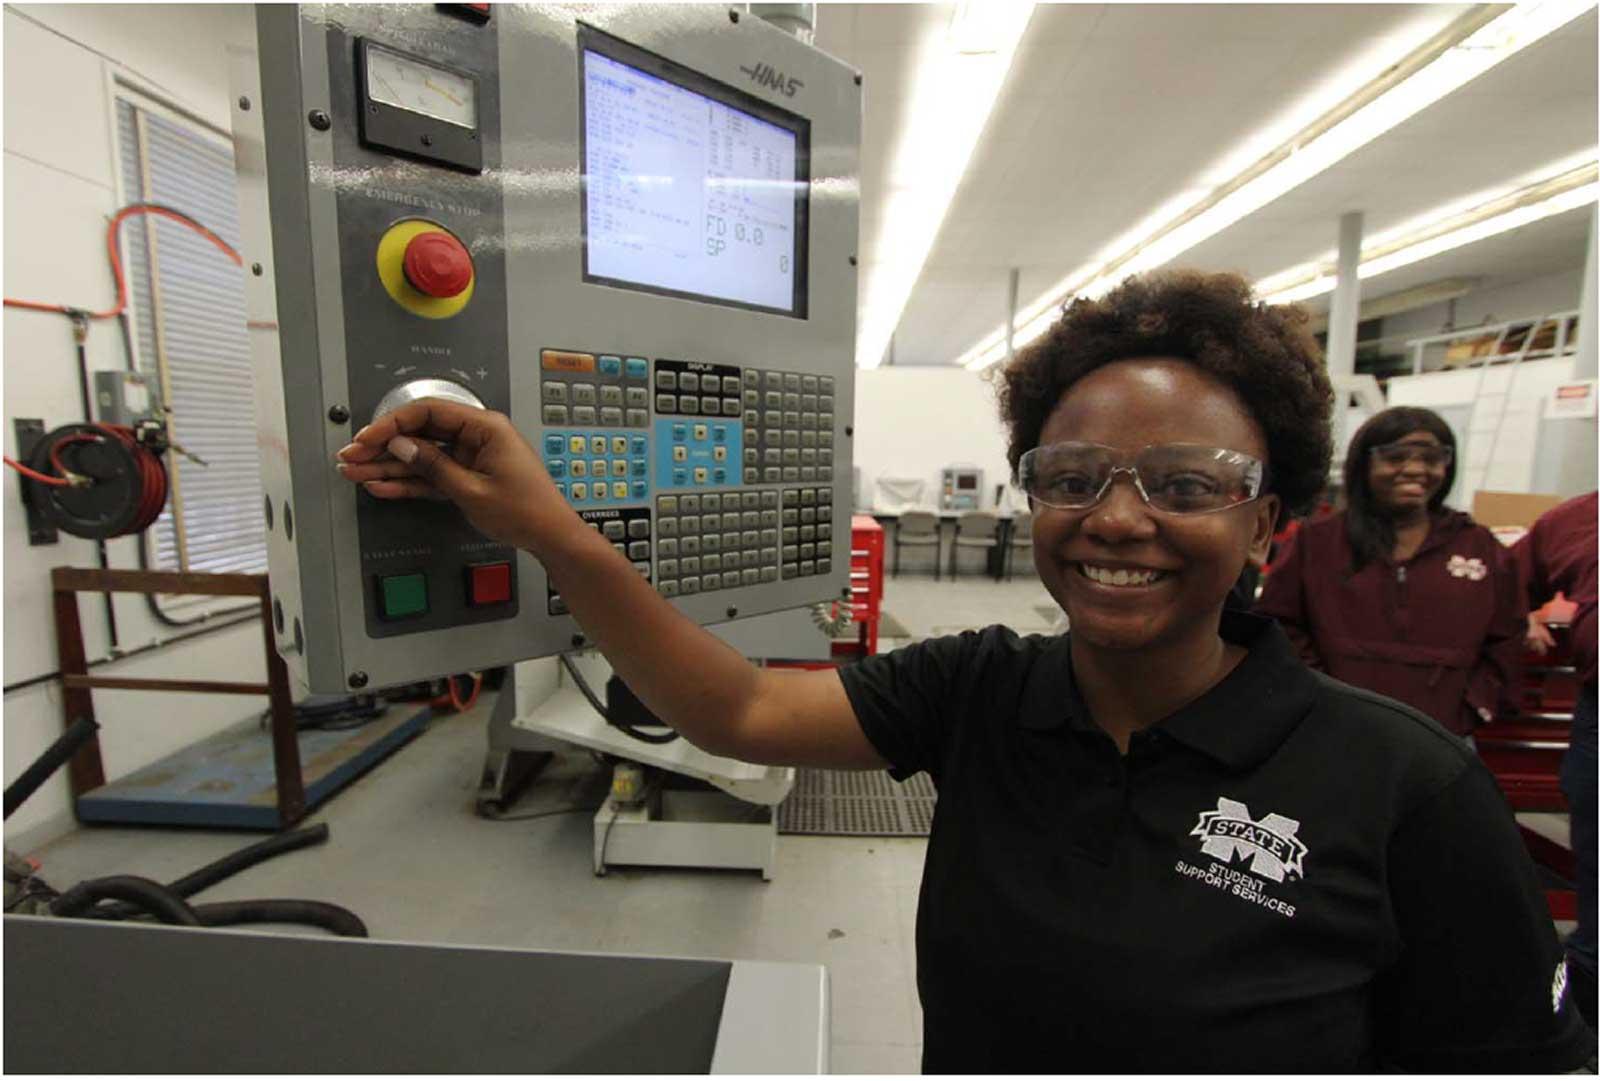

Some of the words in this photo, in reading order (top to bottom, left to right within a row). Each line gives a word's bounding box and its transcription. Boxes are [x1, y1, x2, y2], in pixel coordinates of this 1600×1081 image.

[706, 213, 726, 237] FD
[706, 236, 726, 257] SP
[1214, 820, 1286, 857] STATE
[1174, 860, 1233, 891] SUPPORT
[1231, 884, 1297, 918] SERVICES
[1208, 862, 1268, 893] STUDENT
